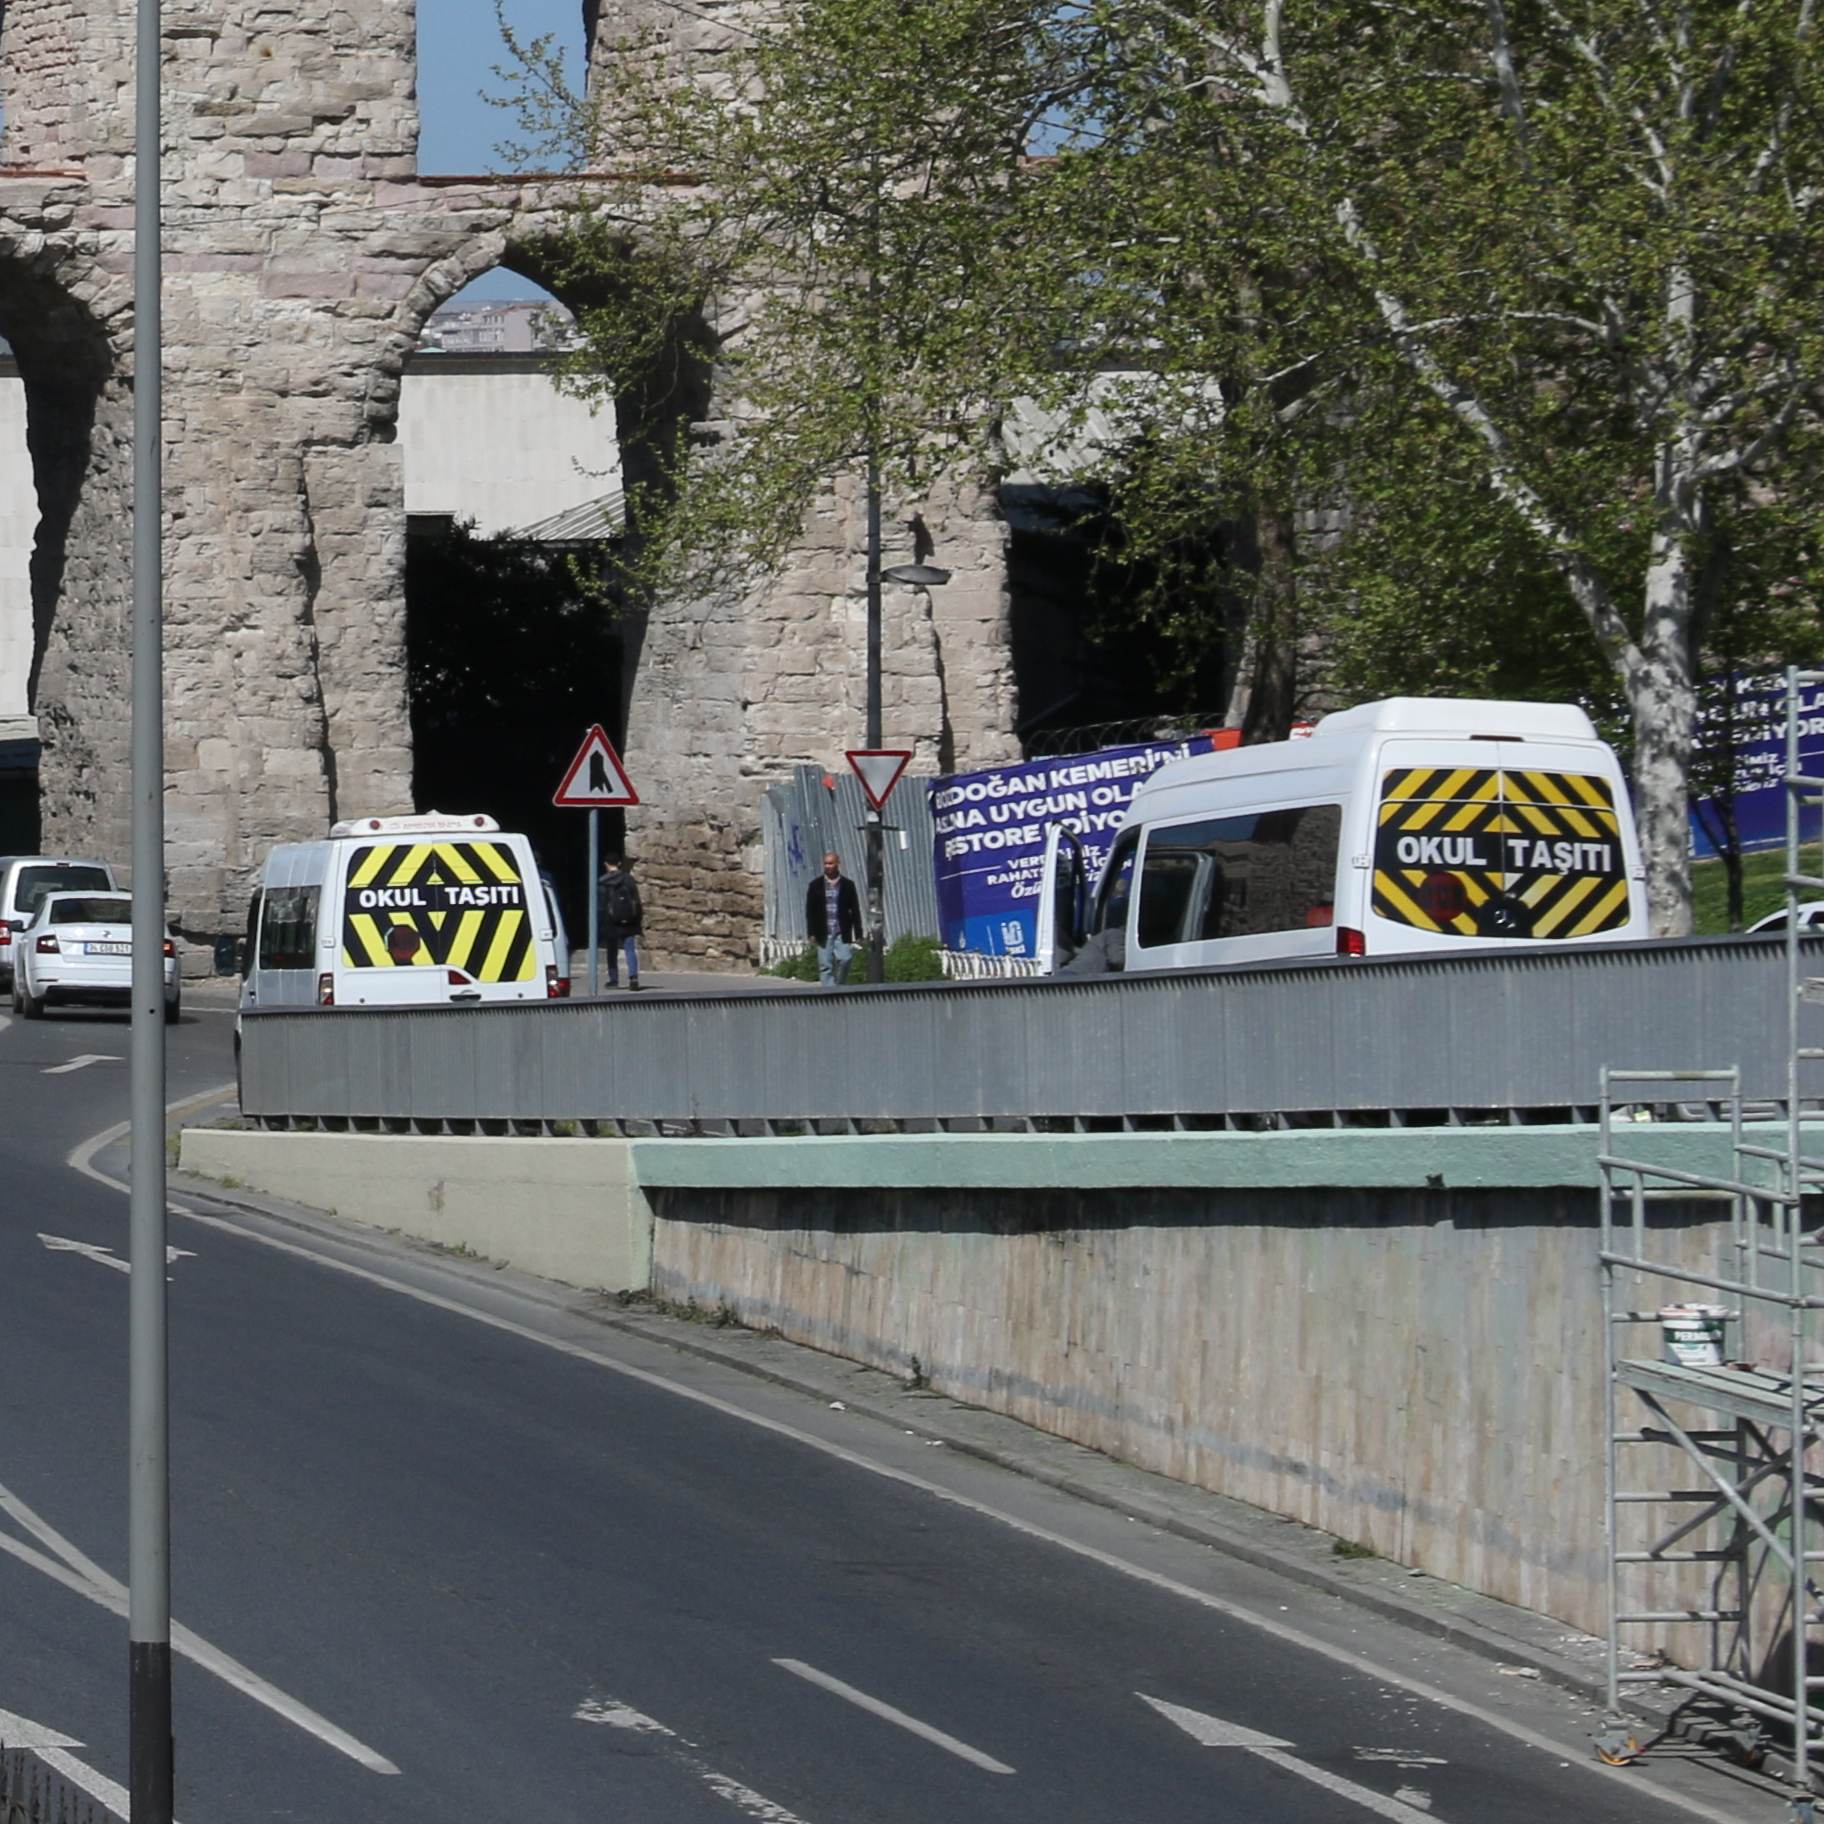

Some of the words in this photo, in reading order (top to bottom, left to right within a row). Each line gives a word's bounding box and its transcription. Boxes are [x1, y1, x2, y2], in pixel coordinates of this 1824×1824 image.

[990, 790, 1087, 823] UYGUN
[945, 823, 1042, 861] STORE
[1396, 836, 1487, 866] OKUL
[1507, 838, 1611, 876] TAŞITI
[359, 888, 427, 908] OKUL
[444, 886, 519, 906] TAŞITI
